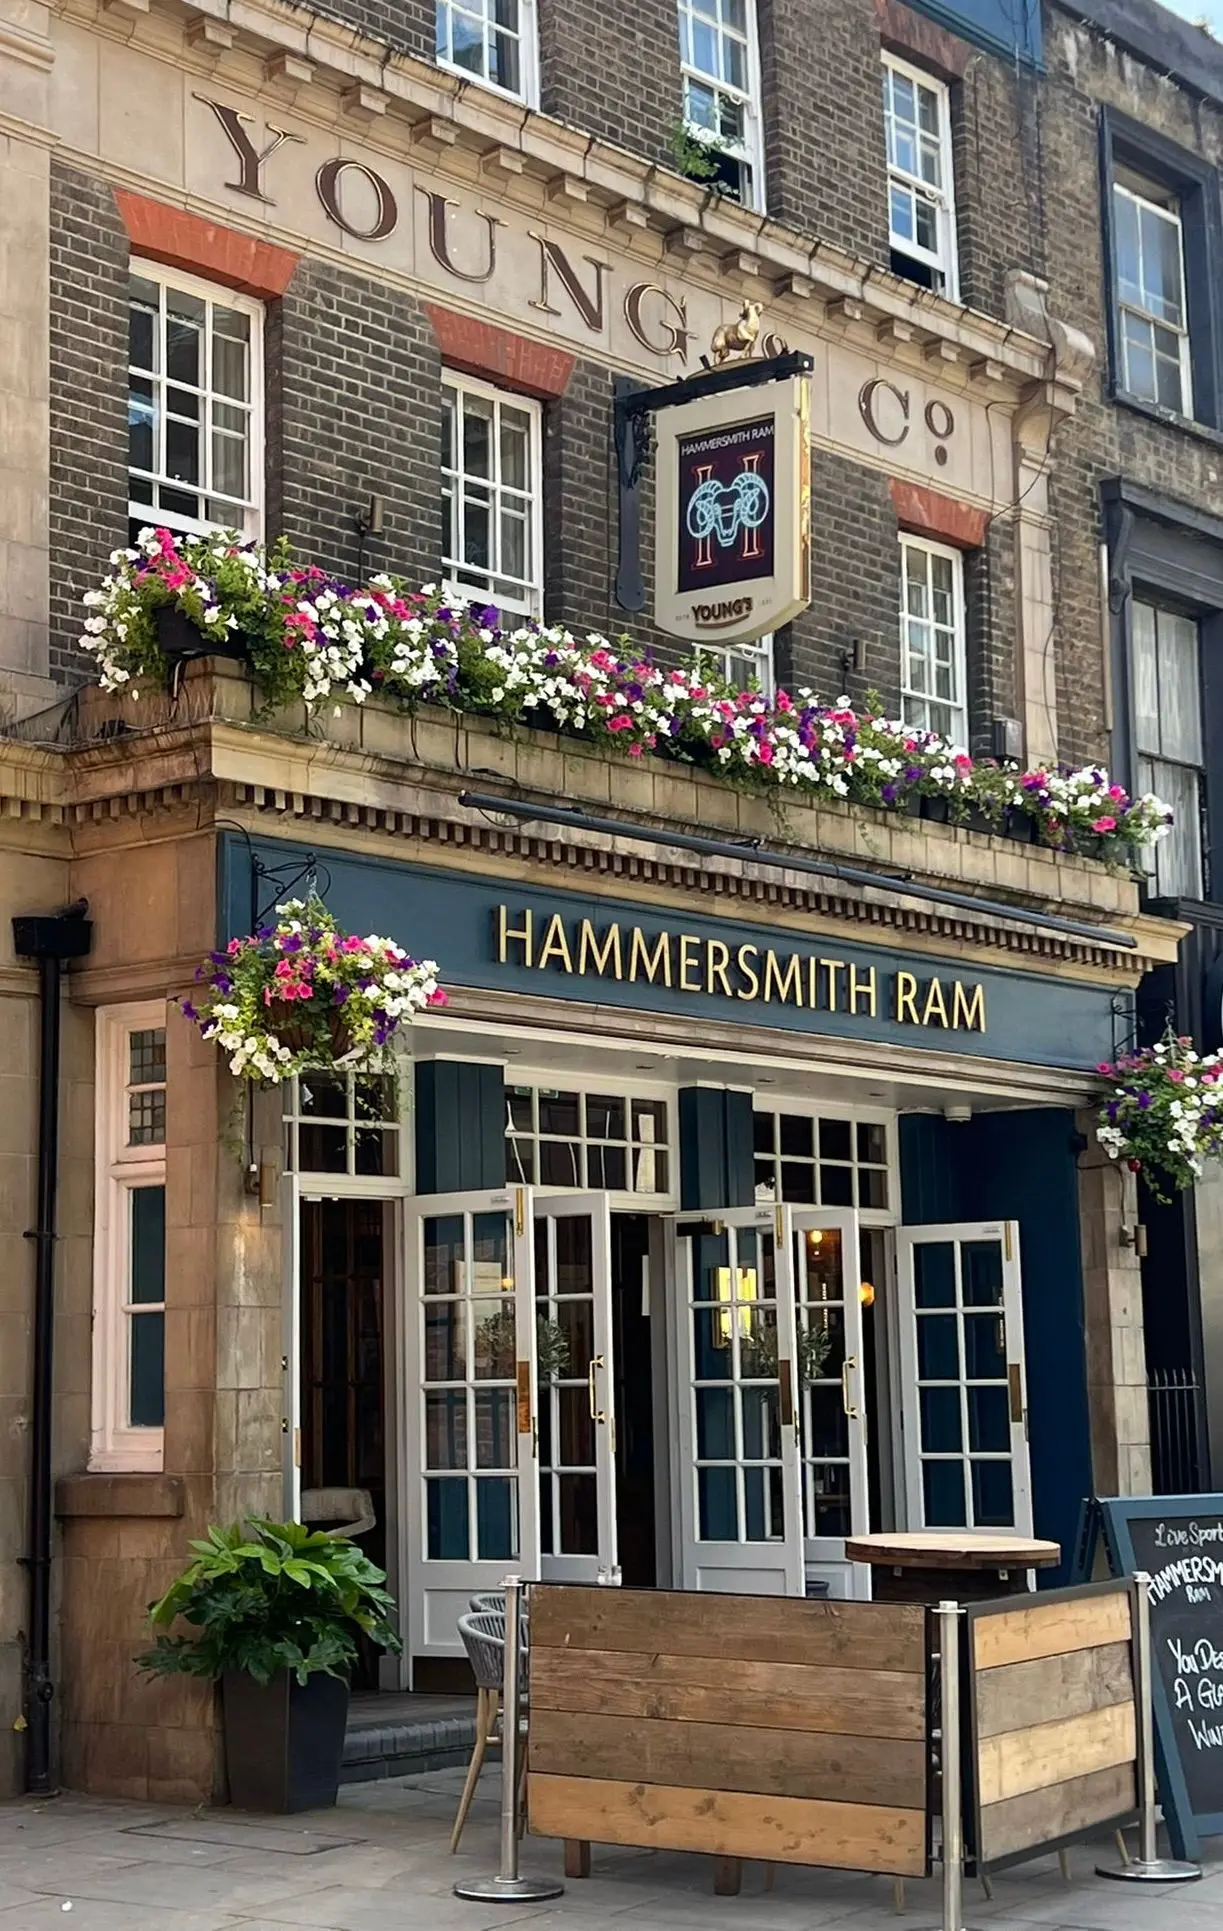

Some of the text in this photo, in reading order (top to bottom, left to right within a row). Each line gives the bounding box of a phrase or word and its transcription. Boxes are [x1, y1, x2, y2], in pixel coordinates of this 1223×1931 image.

[191, 91, 699, 367] YOUNG
[681, 424, 775, 457] HAMMERSMITH RAM
[691, 597, 753, 622] YOUNG'S
[498, 904, 987, 1034] HAMMERSMITH RAM
[1155, 1523, 1189, 1547] Live
[1174, 1677, 1194, 1712] A
